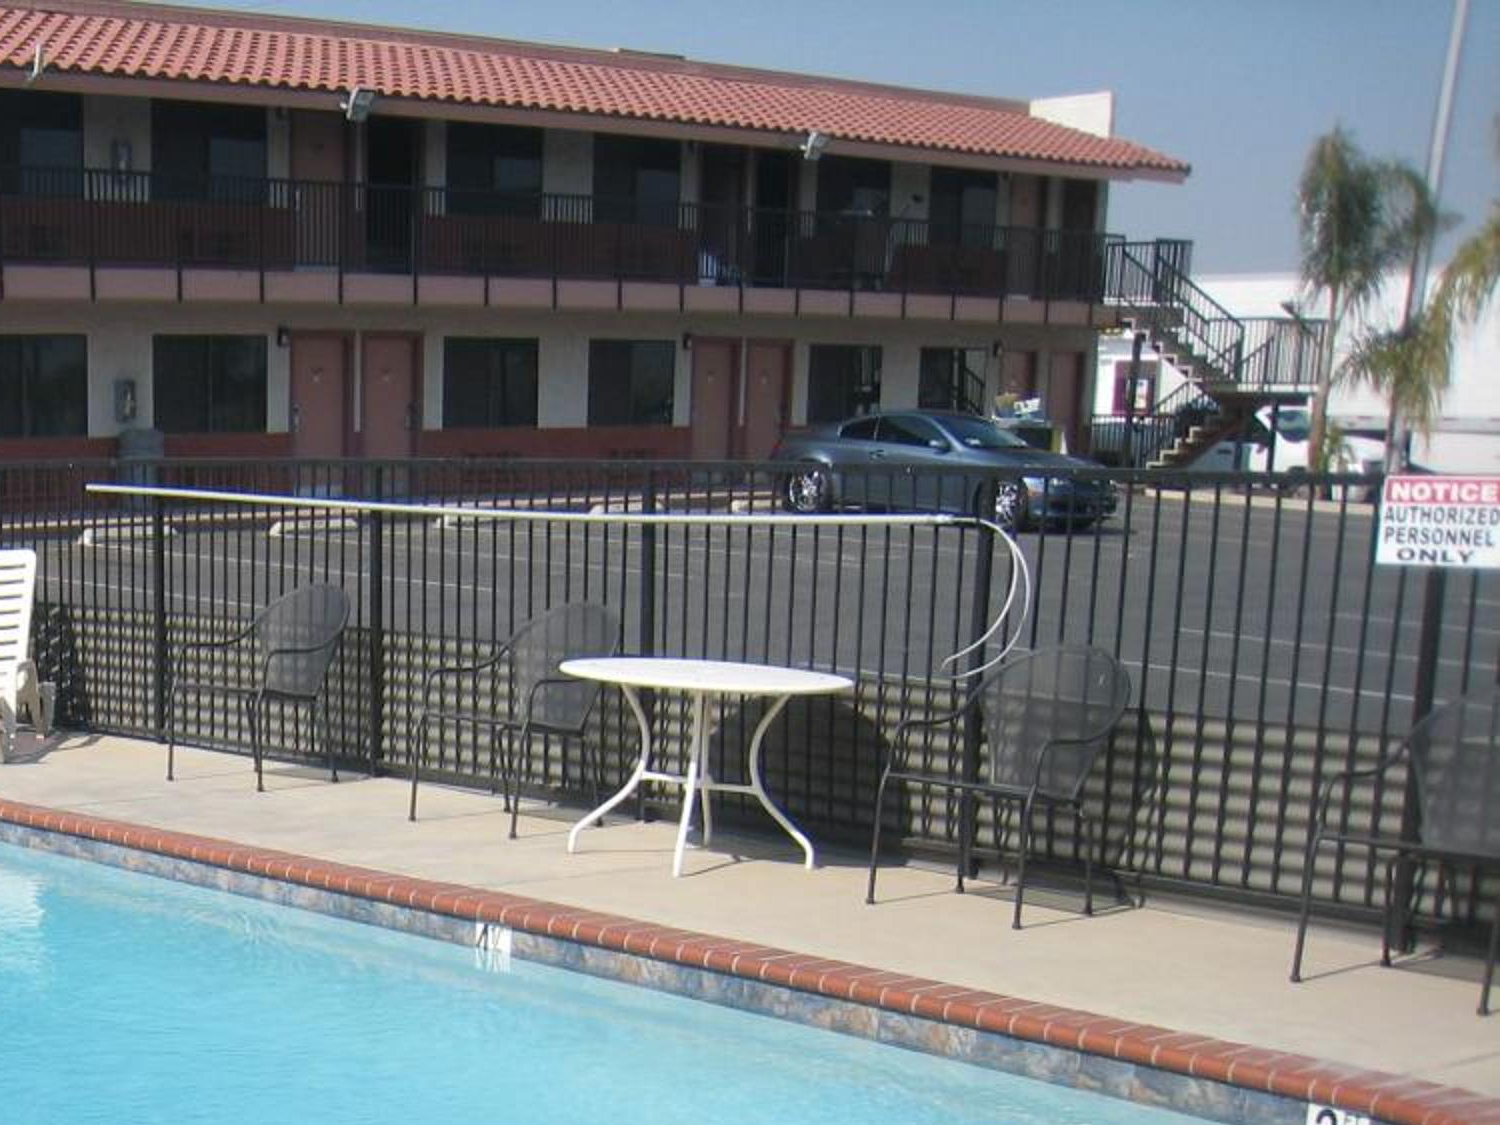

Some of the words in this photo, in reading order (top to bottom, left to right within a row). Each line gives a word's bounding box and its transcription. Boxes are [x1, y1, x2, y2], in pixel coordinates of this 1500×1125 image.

[1390, 481, 1499, 502] NOTICE
[1384, 507, 1500, 526] AUTHORIZED
[1384, 527, 1495, 547] PERSONNEL
[1396, 547, 1474, 563] ONLY
